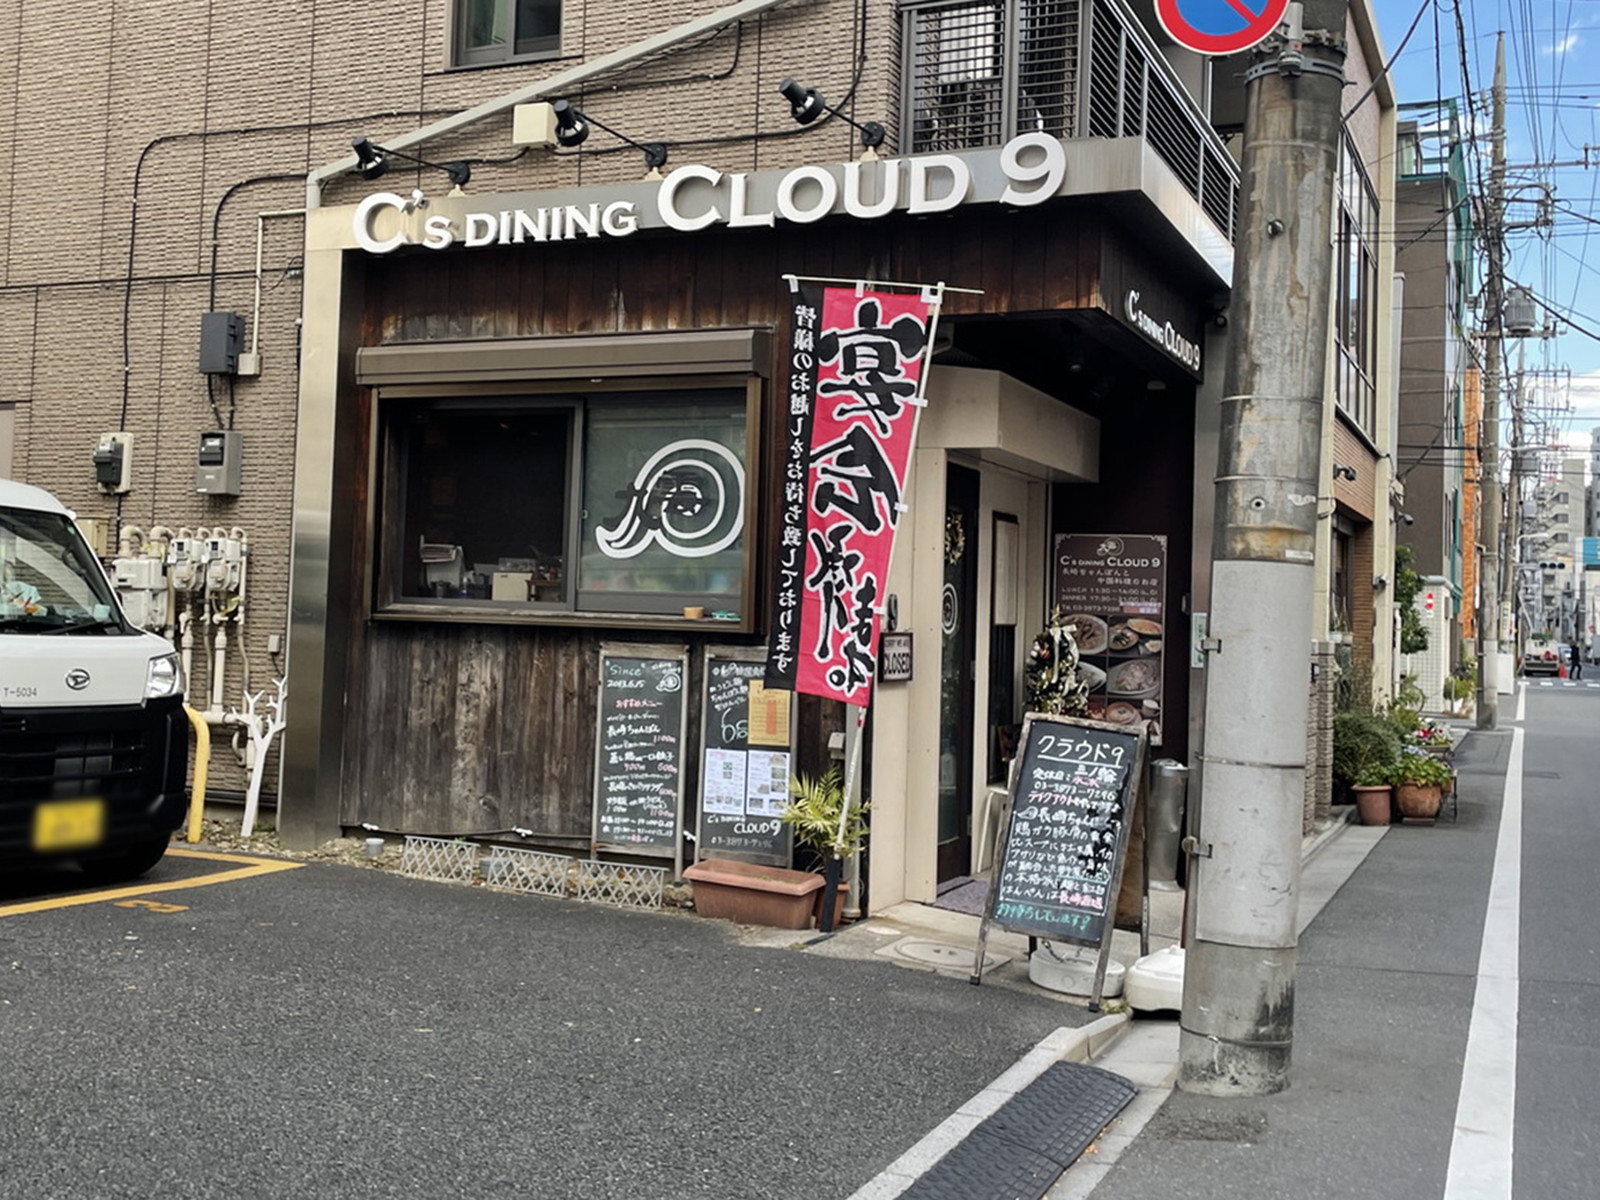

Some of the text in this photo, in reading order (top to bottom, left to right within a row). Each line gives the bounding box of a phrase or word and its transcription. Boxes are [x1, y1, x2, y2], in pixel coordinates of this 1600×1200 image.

[463, 201, 638, 248] DINING
[657, 153, 973, 233] CLOUD
[999, 131, 1068, 206] 9
[1164, 320, 1193, 366] CLOUD
[1193, 344, 1201, 372] 9
[1106, 556, 1149, 567] CLOUD
[1151, 557, 1161, 568] 9
[4, 687, 38, 698] T-5034
